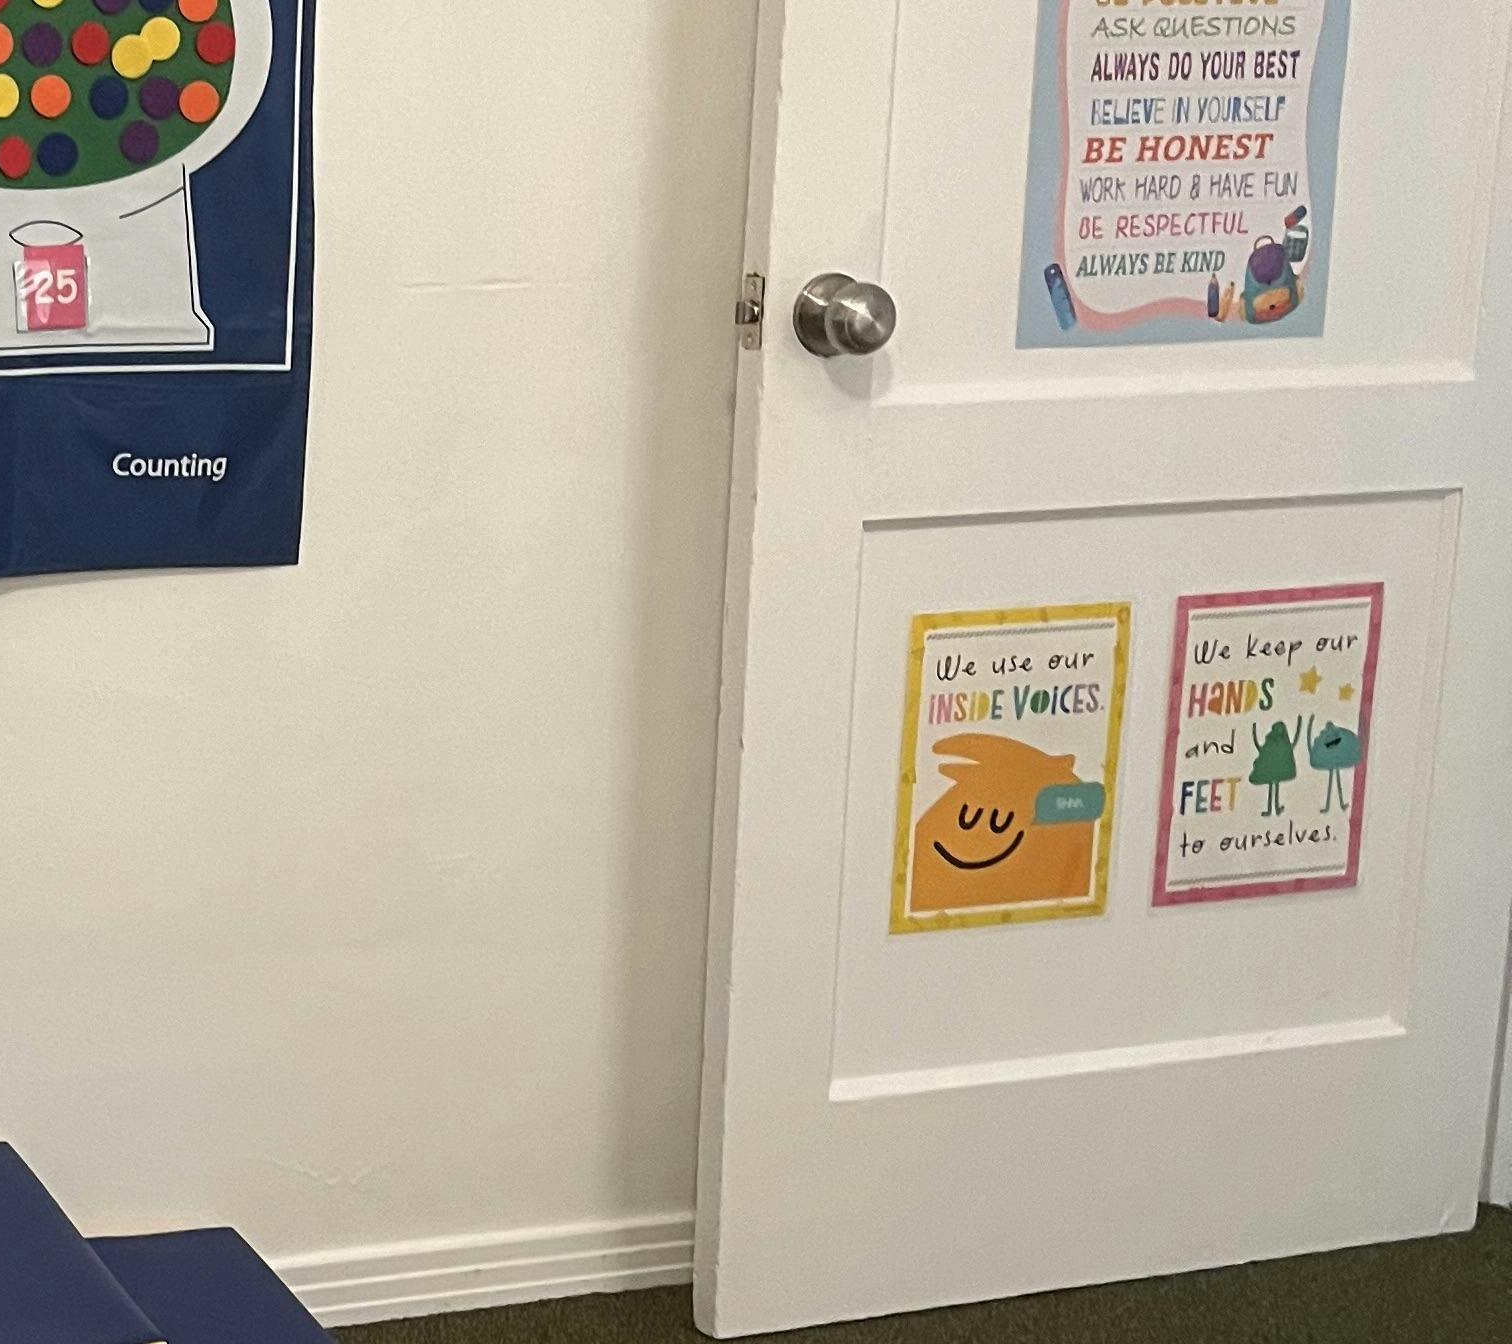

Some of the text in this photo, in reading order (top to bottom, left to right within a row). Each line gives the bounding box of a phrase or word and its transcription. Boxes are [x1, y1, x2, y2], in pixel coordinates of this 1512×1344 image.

[1091, 15, 1296, 39] ASK QUESTIONS
[1090, 49, 1301, 82] ALWAYS DO YOUR BEST
[1091, 95, 1286, 125] BELIEVE IN YOURSELF
[1082, 133, 1274, 164] BE HONEST
[1079, 176, 1126, 203] WORK
[1134, 174, 1182, 201] HARD
[1209, 172, 1255, 199] HAVE
[1263, 171, 1299, 198] FUN
[1078, 211, 1249, 240] BE RESPECTFUL
[1075, 250, 1226, 278] ALWAYS BE KIND
[34, 269, 78, 304] 25
[111, 452, 228, 483] Counting
[1193, 633, 1359, 667] We keep our
[936, 651, 1095, 682] We use our
[1185, 728, 1238, 759] and
[1180, 777, 1243, 816] FEET
[1179, 819, 1338, 858] to ourselves.
